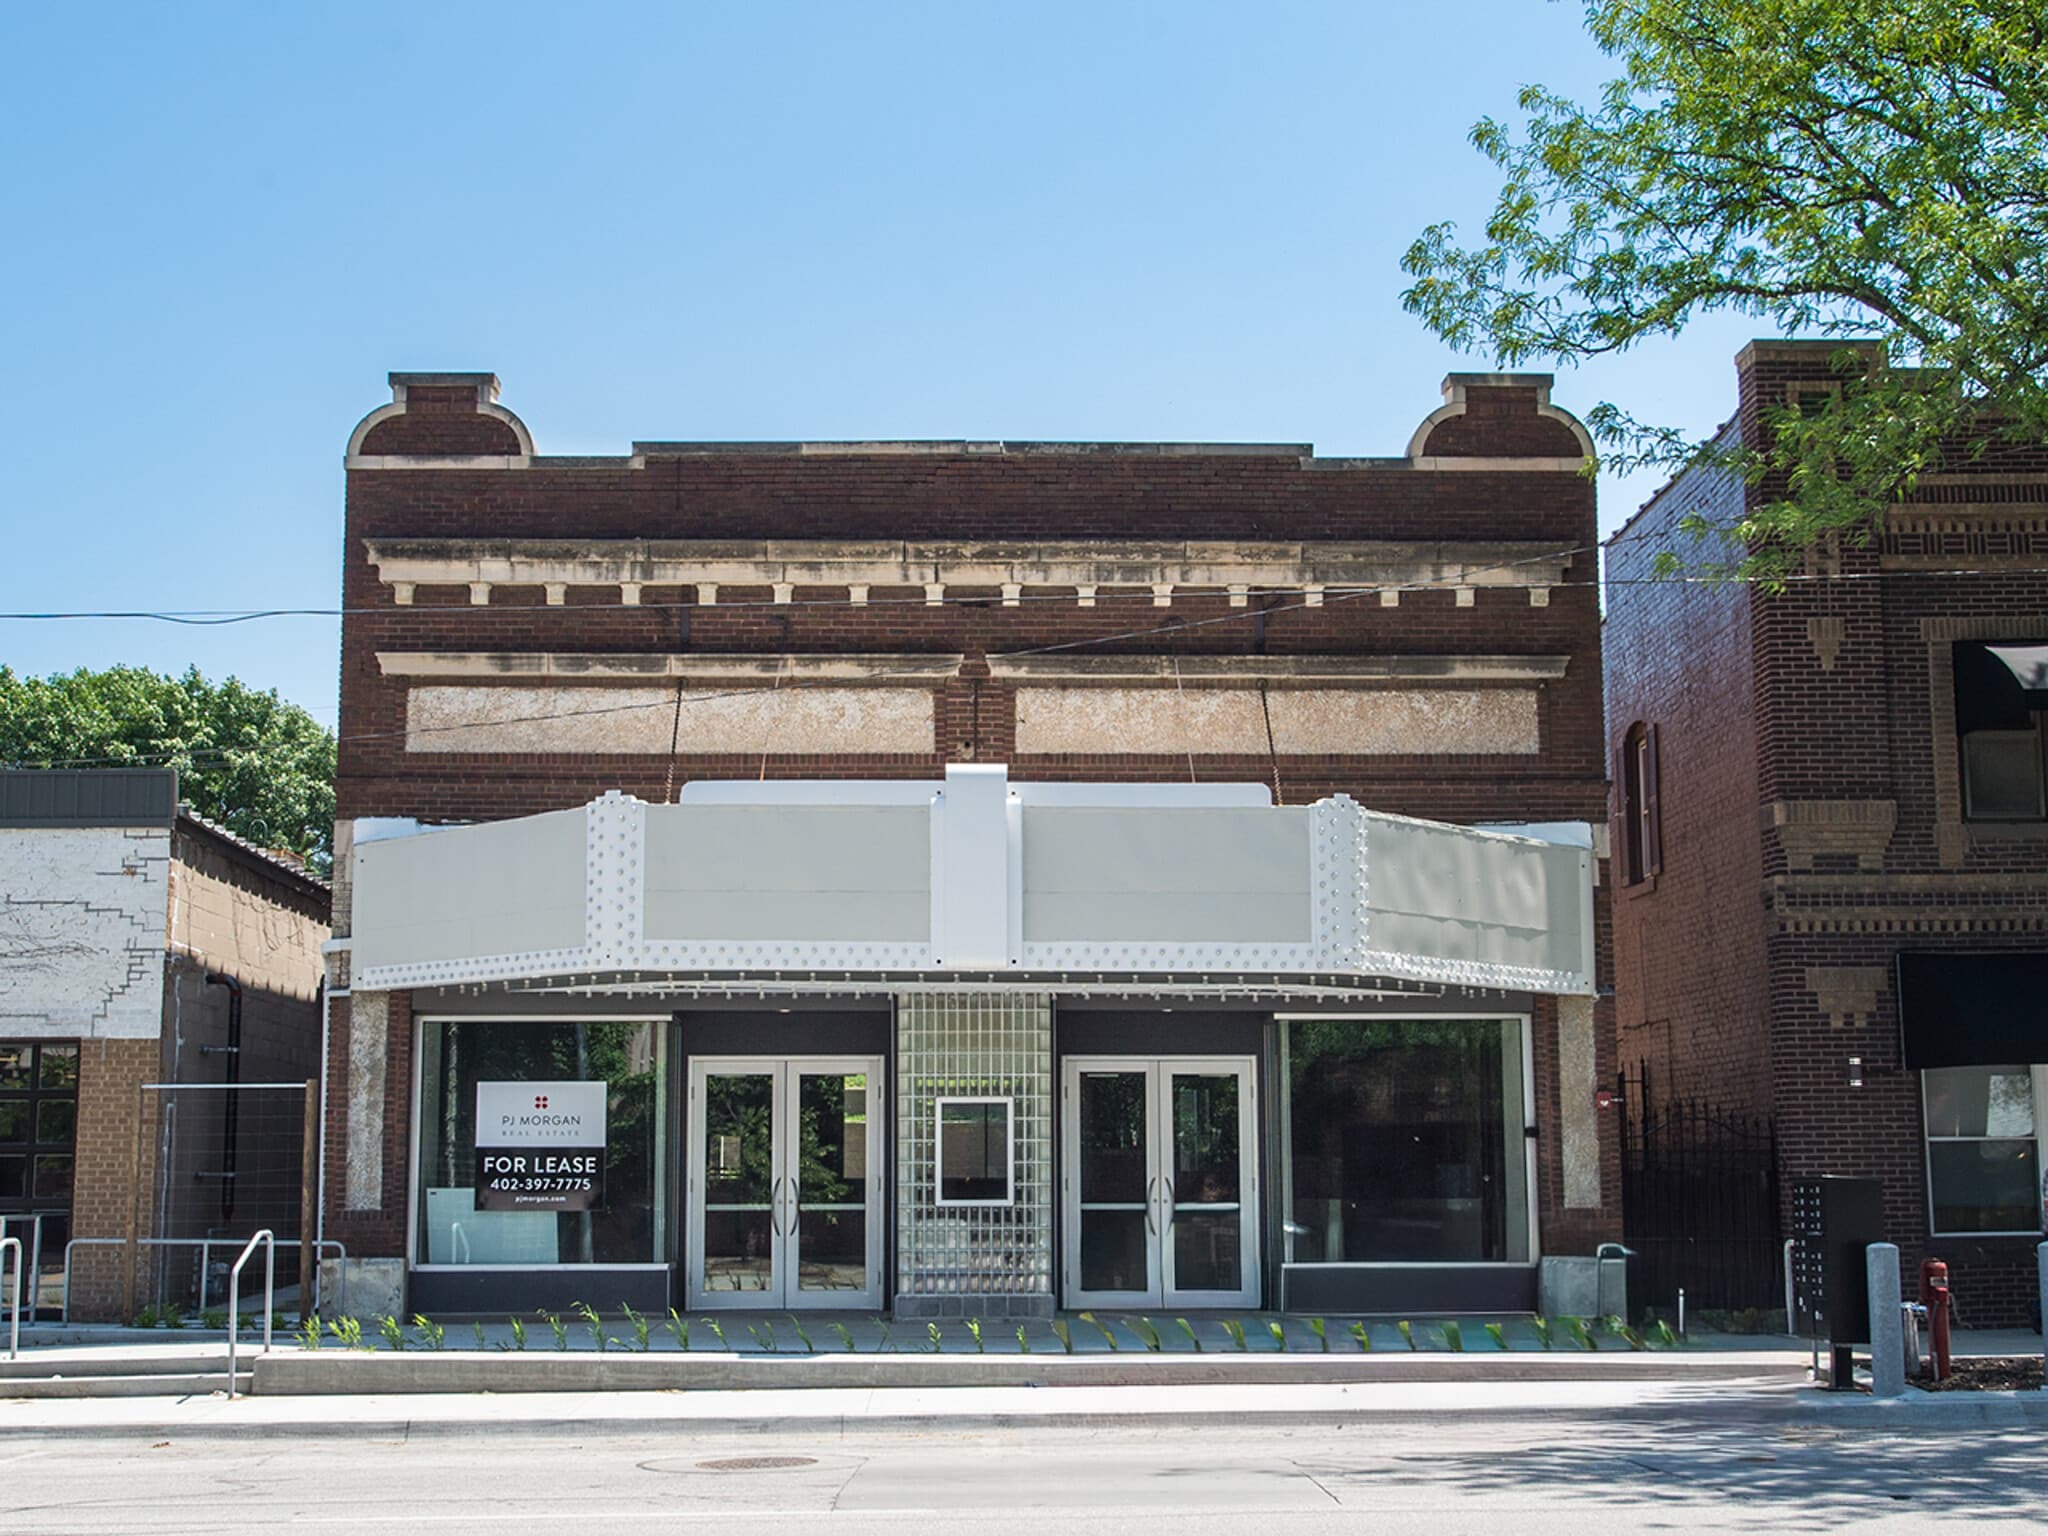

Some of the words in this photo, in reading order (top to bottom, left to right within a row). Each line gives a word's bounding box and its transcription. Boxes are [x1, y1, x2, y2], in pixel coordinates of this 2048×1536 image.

[502, 1115, 515, 1126] PJ
[520, 1115, 581, 1126] MORGAN
[484, 1156, 527, 1173] FOR
[534, 1157, 597, 1173] LEASE
[490, 1178, 592, 1191] 402-397-7775
[515, 1195, 567, 1204] pjmorgan.com
